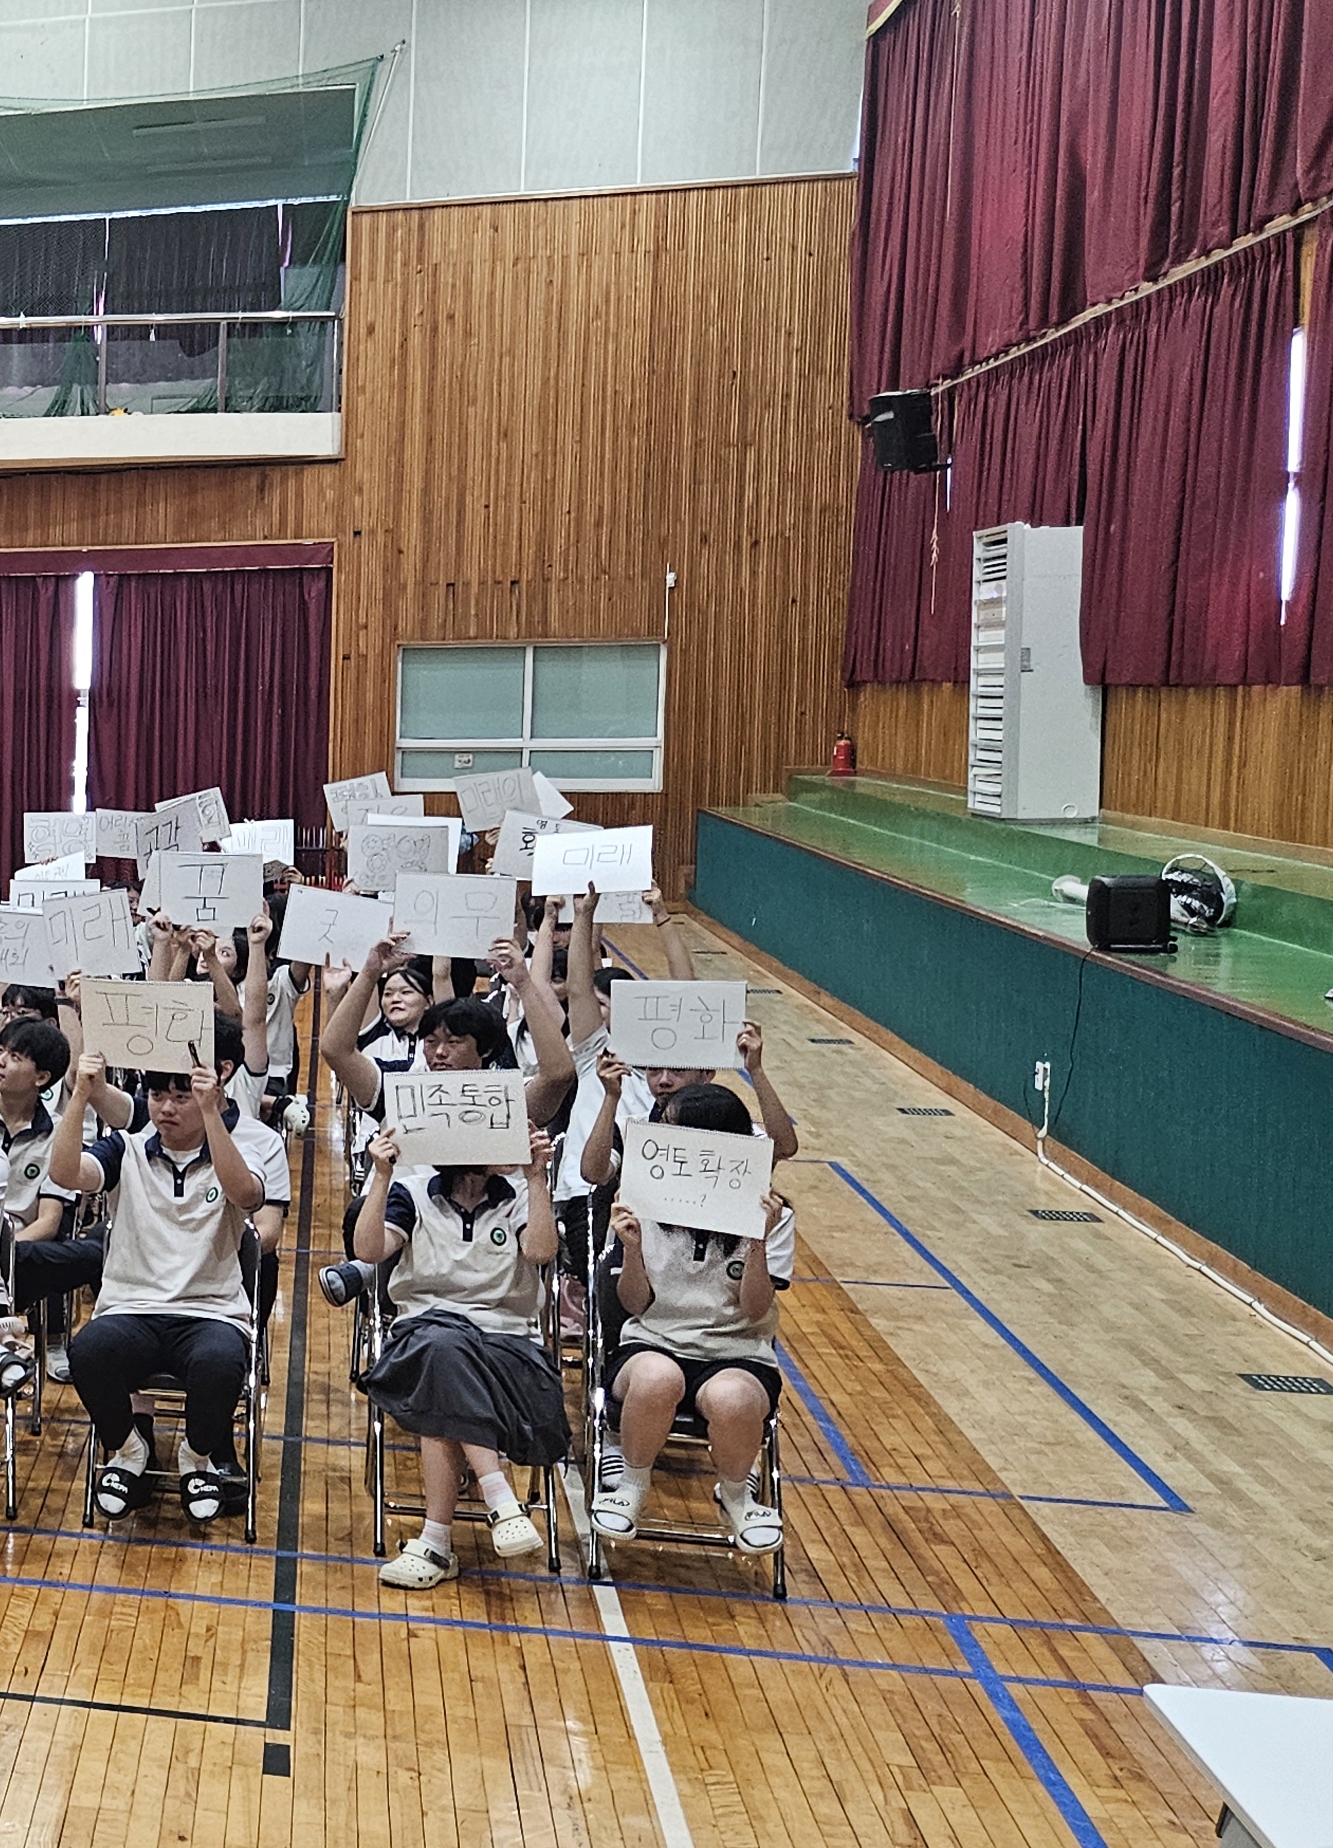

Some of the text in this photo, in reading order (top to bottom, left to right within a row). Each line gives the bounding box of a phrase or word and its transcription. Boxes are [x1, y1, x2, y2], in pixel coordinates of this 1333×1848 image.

[177, 862, 230, 922] 꿈
[404, 889, 501, 939] 의무
[48, 896, 131, 961] 미래
[95, 991, 213, 1057] 평화
[635, 995, 740, 1050] 평화
[393, 1083, 517, 1135] 민족통합
[641, 1138, 753, 1191] 영토 확장
